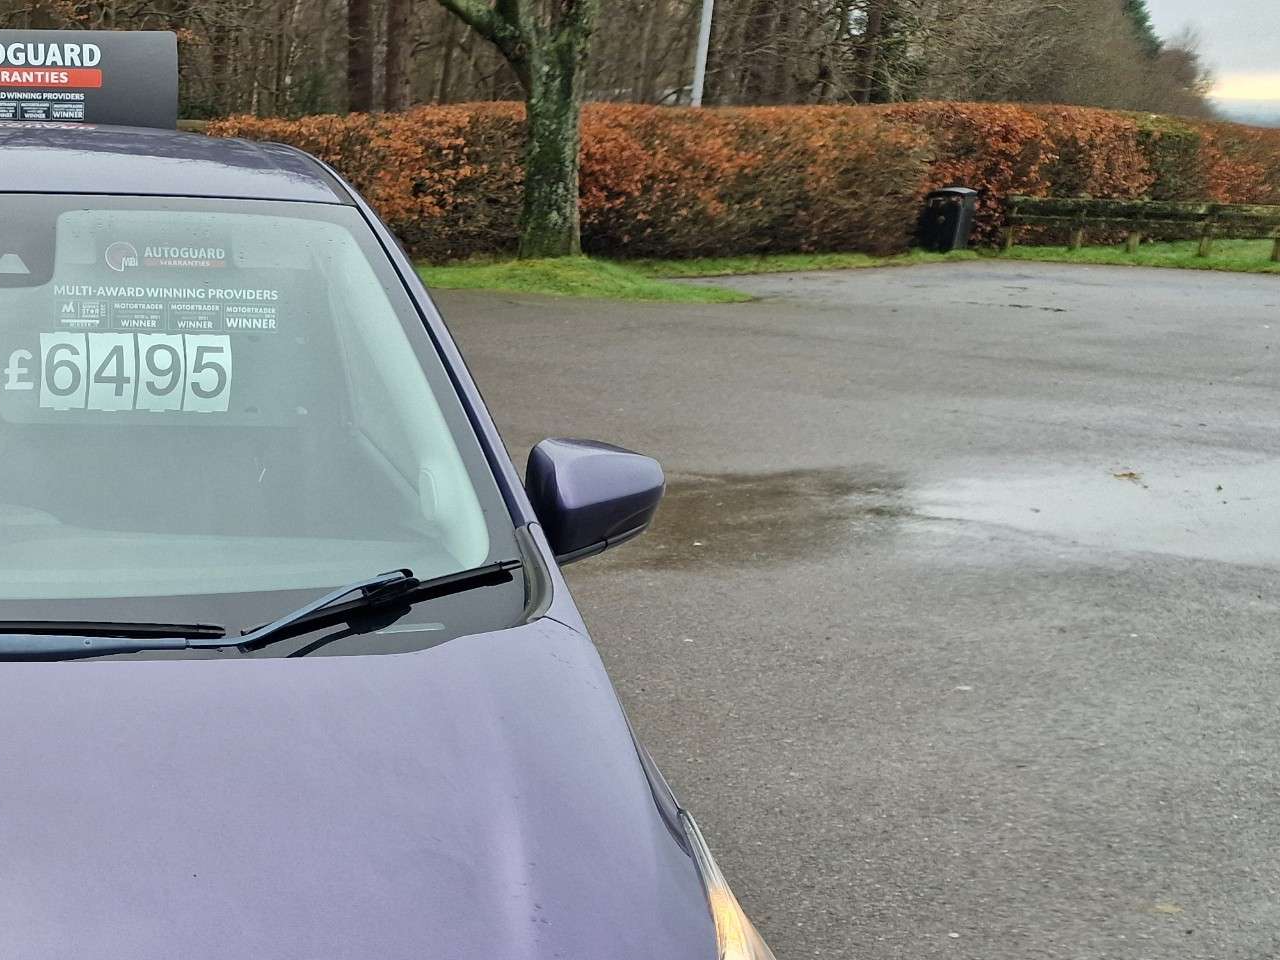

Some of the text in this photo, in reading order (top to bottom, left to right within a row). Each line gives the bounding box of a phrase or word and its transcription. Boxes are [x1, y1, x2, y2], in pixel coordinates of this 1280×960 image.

[43, 92, 85, 100] PROVIDERS
[53, 111, 83, 119] WINNER
[143, 246, 225, 259] AUTOGUARD
[54, 285, 279, 300] MULTI-AWARD WINNING PROVIDERS
[120, 319, 157, 328] WINNER
[177, 321, 213, 329] WINNER
[226, 318, 276, 329] WINNER
